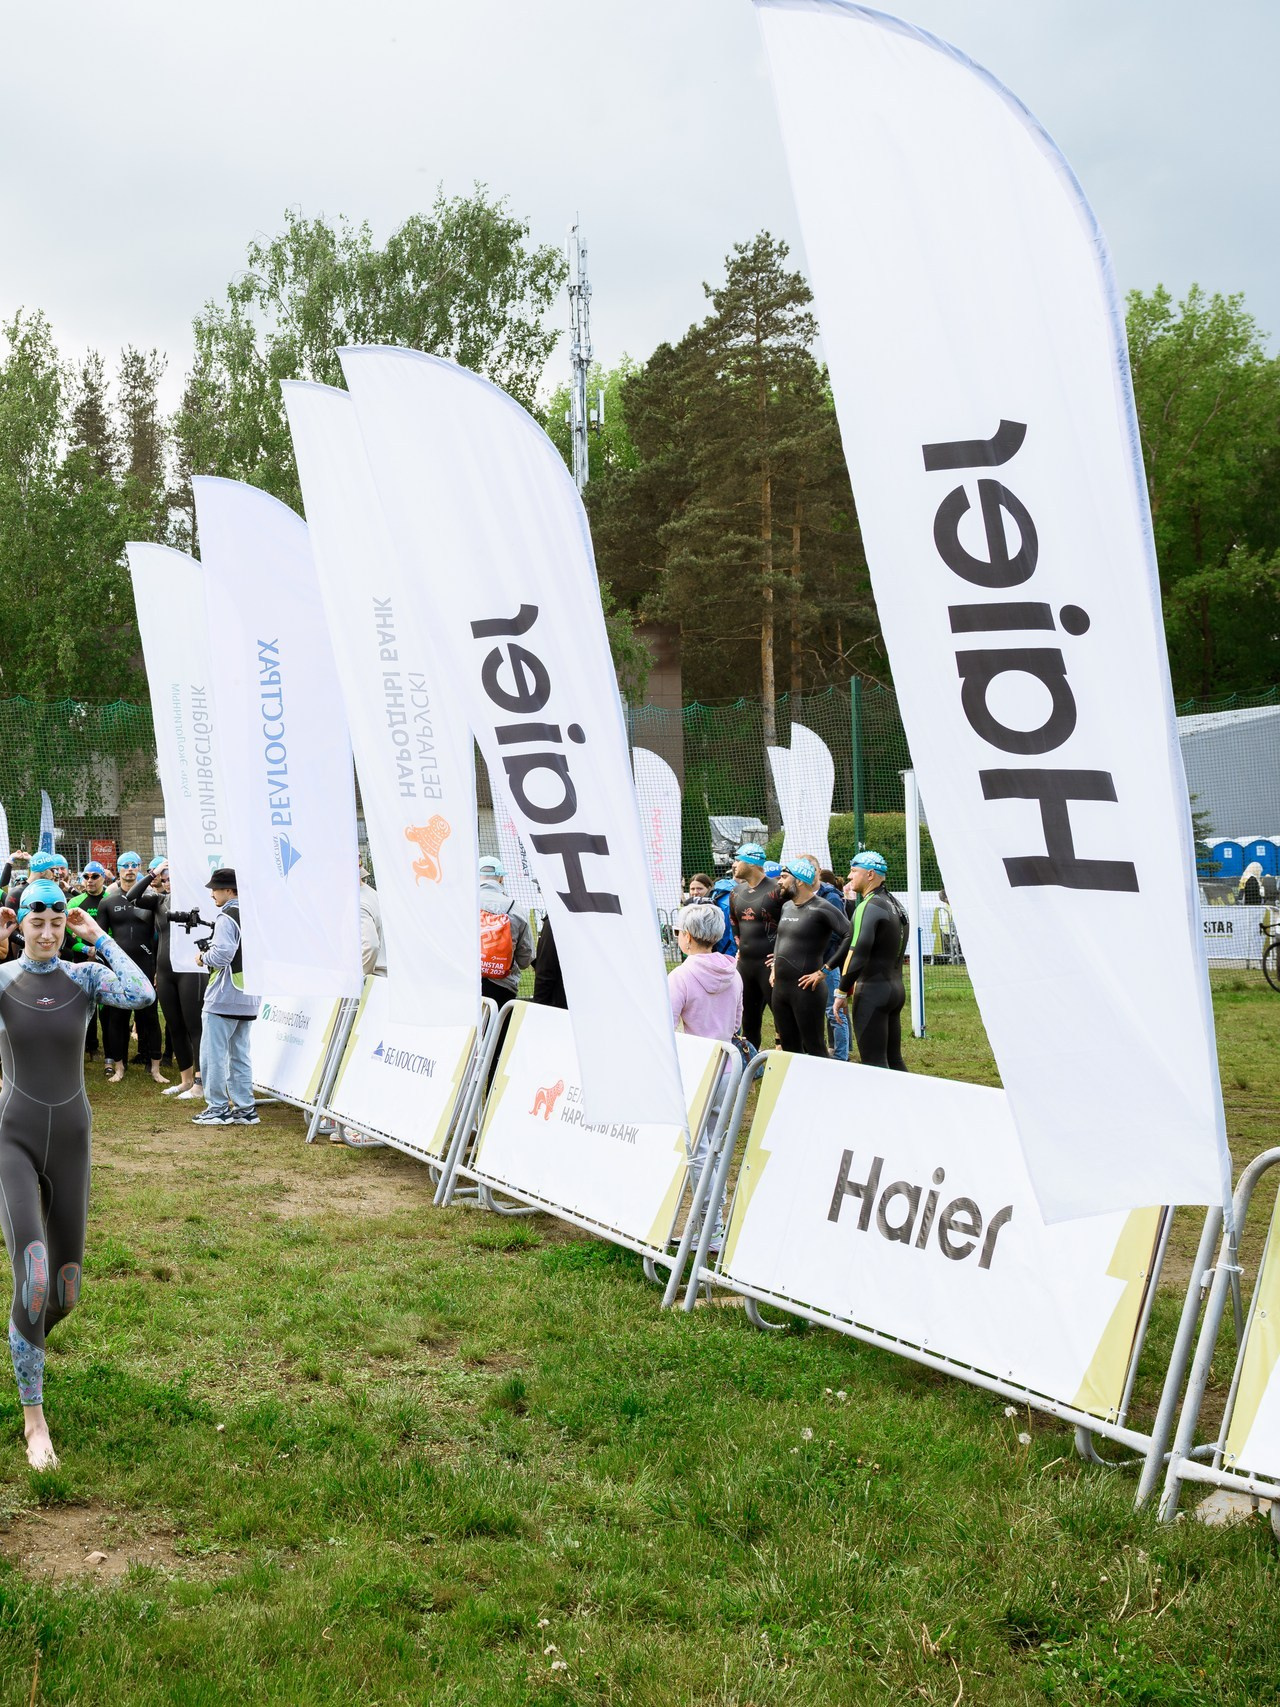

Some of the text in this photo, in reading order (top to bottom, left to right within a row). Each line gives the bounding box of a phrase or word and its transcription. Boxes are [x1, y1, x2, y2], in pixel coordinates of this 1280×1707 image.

[793, 864, 813, 879] STAR
[1203, 921, 1233, 934] STAR
[384, 1047, 437, 1078] БЕЛГОССТРАХ
[827, 1149, 1013, 1270] Haier
